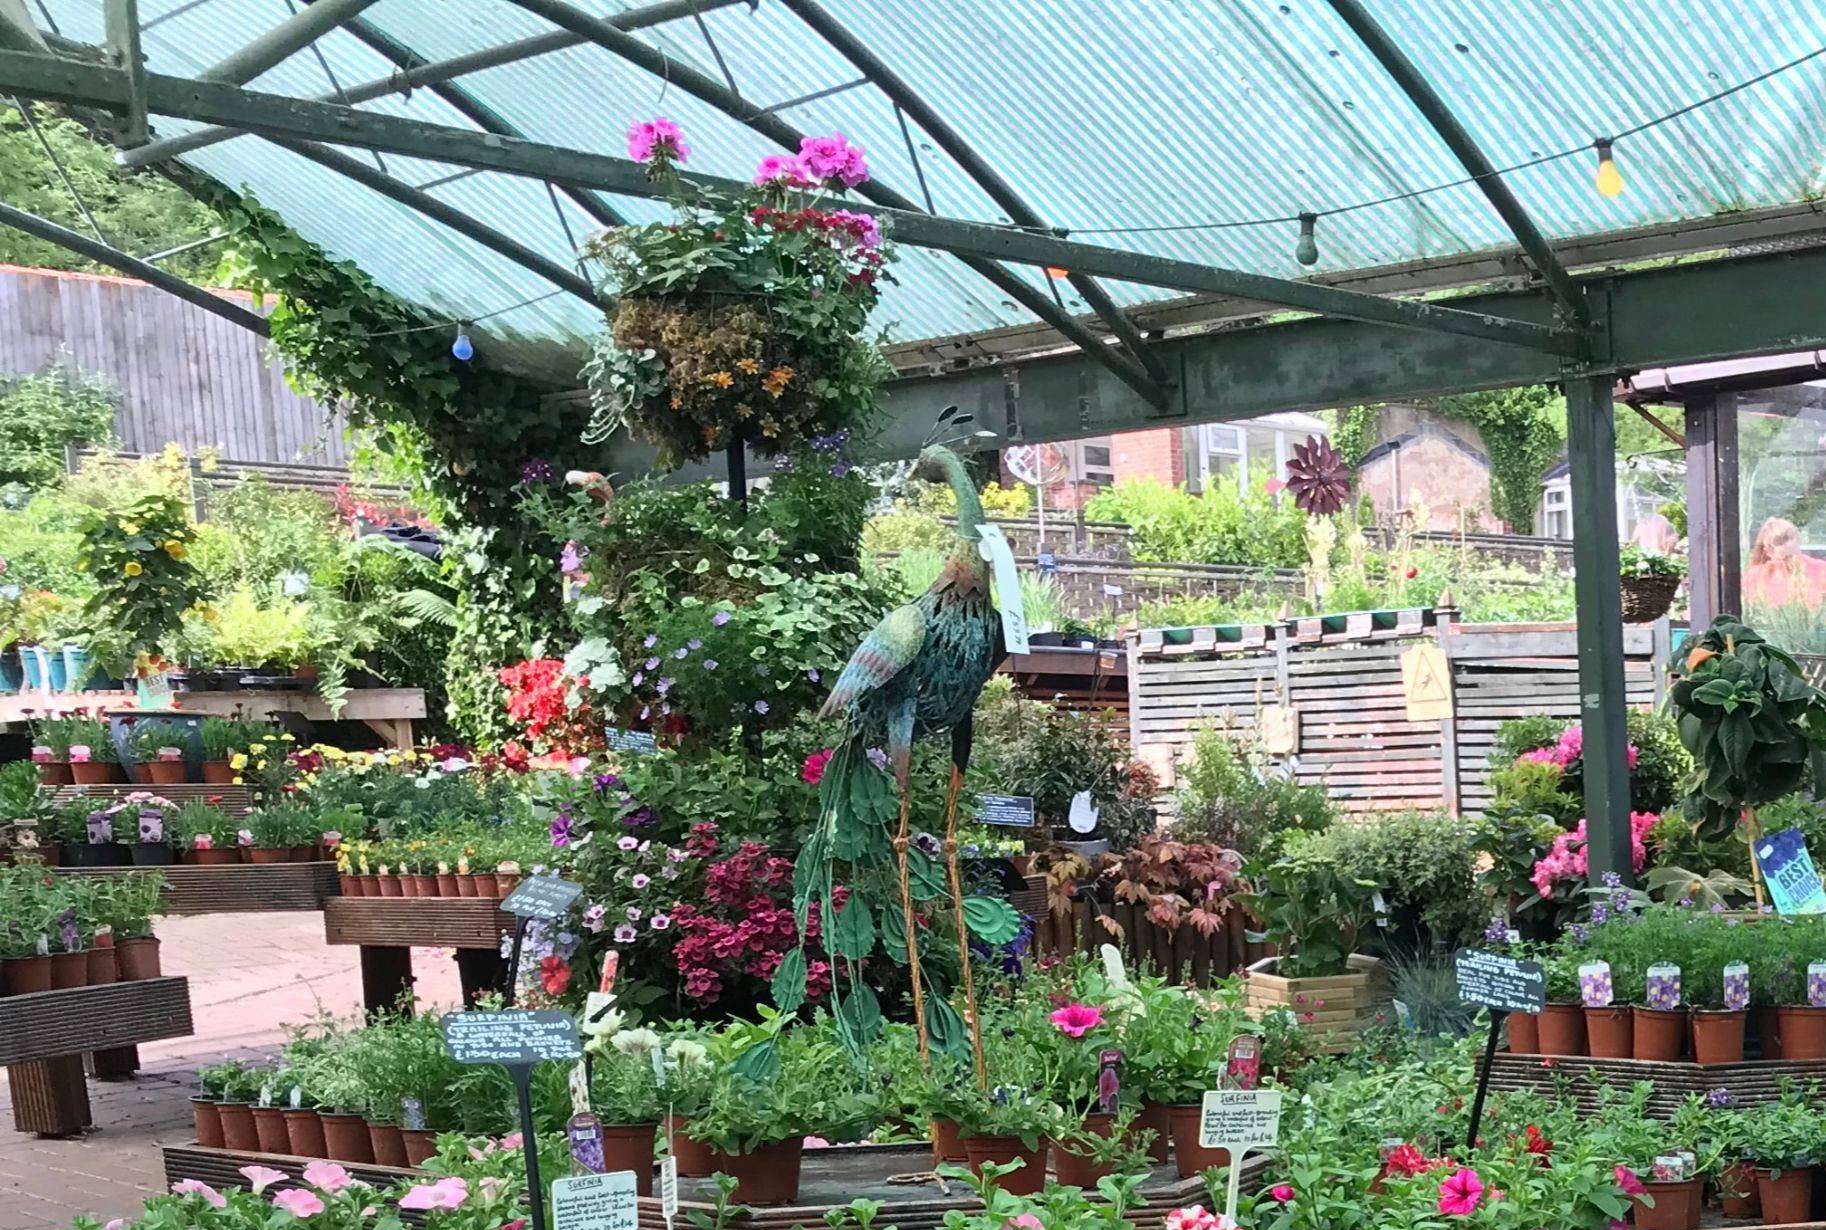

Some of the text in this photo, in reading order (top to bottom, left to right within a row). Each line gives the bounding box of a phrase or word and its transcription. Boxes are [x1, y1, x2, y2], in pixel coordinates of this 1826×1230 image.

[1778, 857, 1809, 890] BEST
[1787, 871, 1820, 901] CHOICE
[1221, 1093, 1257, 1103] SURFINIA
[567, 1178, 603, 1190] SURFINIA
